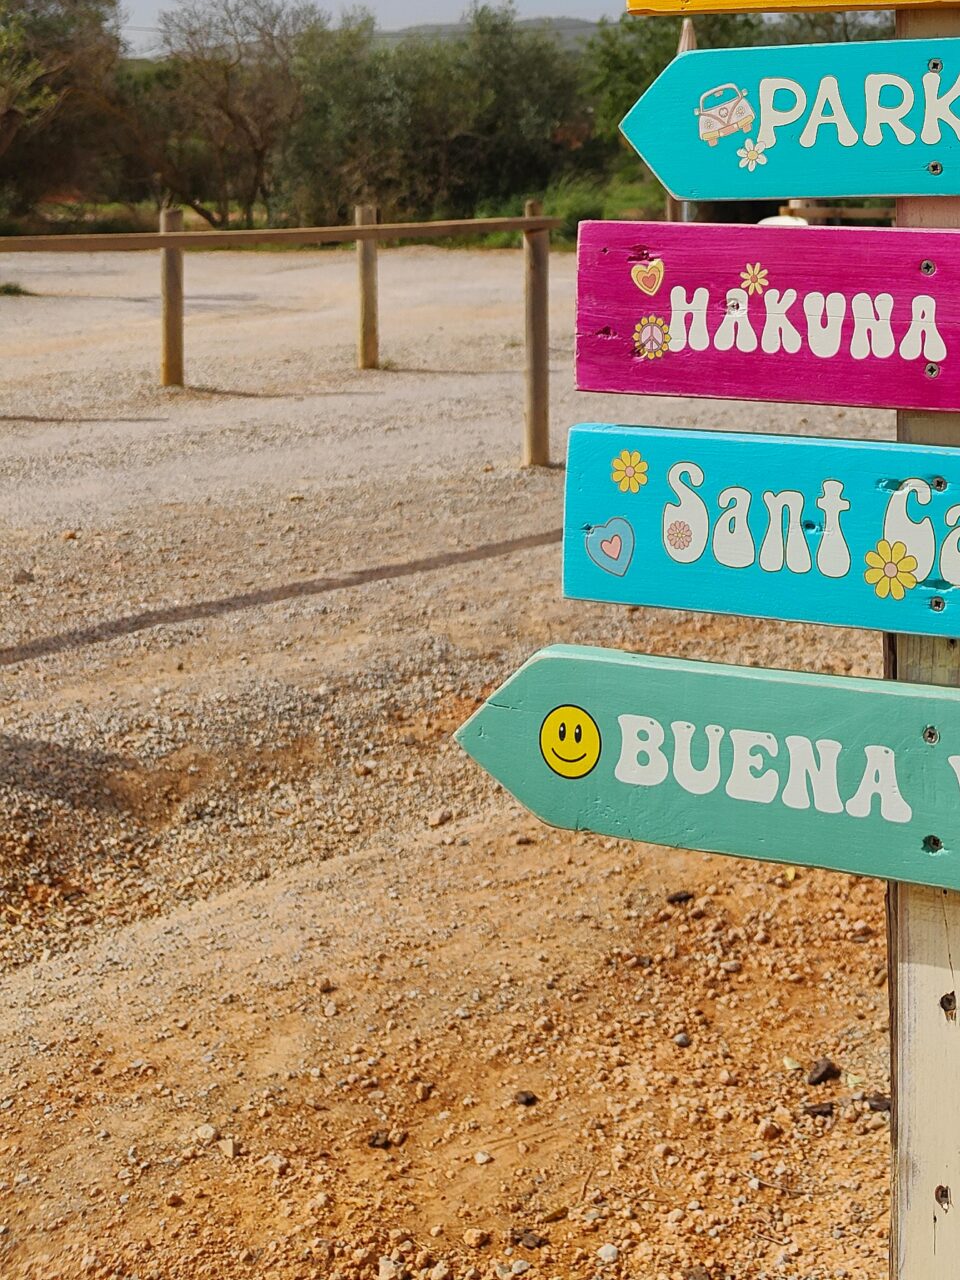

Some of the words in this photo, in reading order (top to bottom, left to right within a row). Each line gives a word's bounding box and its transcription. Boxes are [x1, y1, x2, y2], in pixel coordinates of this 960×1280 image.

[668, 286, 947, 361] HAKUNA
[662, 460, 850, 578] Sant
[614, 714, 913, 823] BUENA
